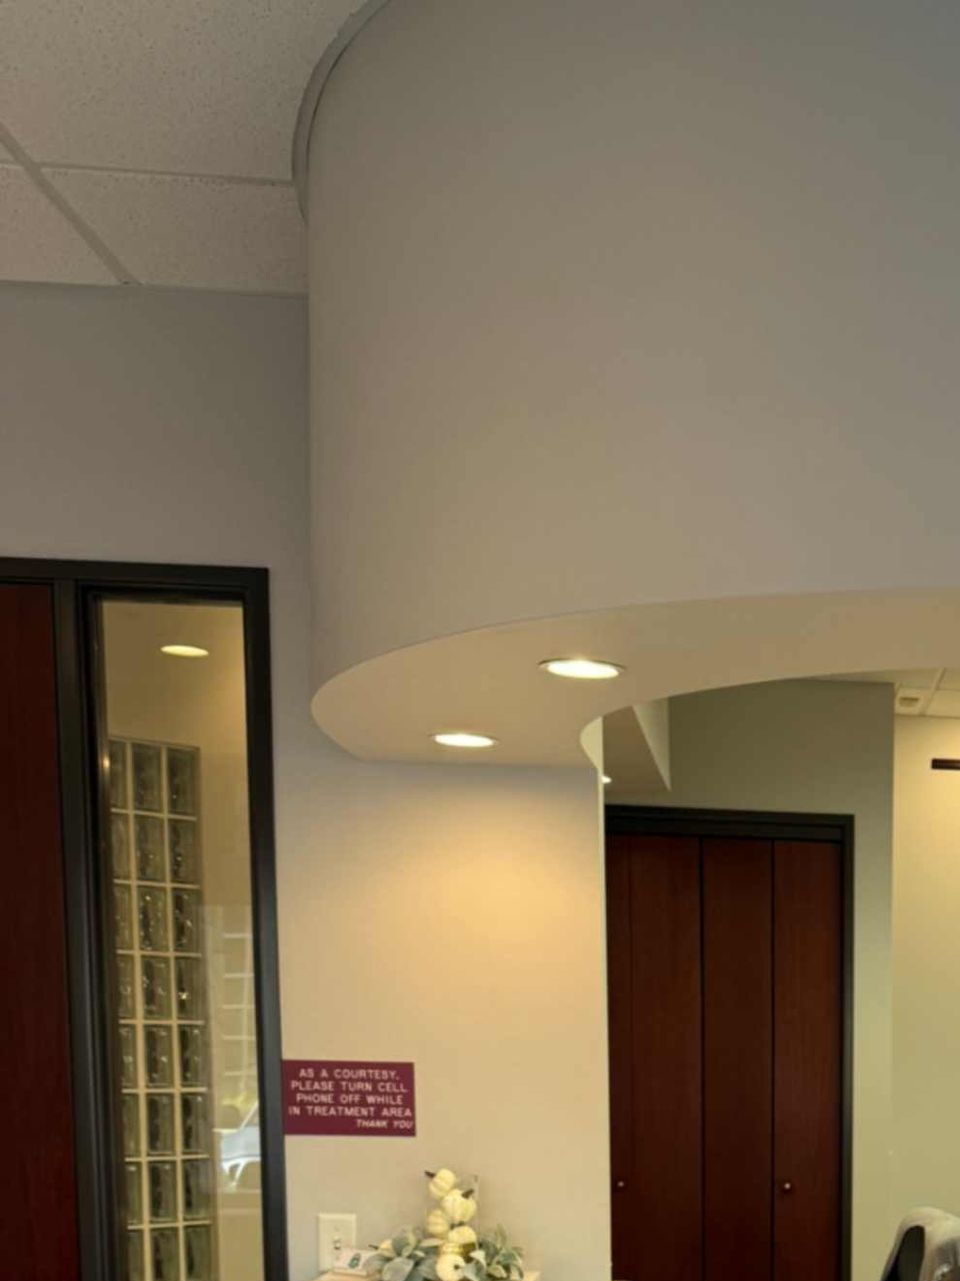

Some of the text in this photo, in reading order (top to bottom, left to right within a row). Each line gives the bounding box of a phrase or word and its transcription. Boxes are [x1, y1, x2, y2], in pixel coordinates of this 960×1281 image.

[299, 1068, 314, 1078] AS
[320, 1068, 329, 1078] A
[291, 1080, 408, 1092] PLEASE TURN CELL
[296, 1093, 403, 1105] PHONE OFF WHILE
[288, 1106, 412, 1117] IN TREATMENT AREA
[356, 1119, 413, 1129] THANK YOU
